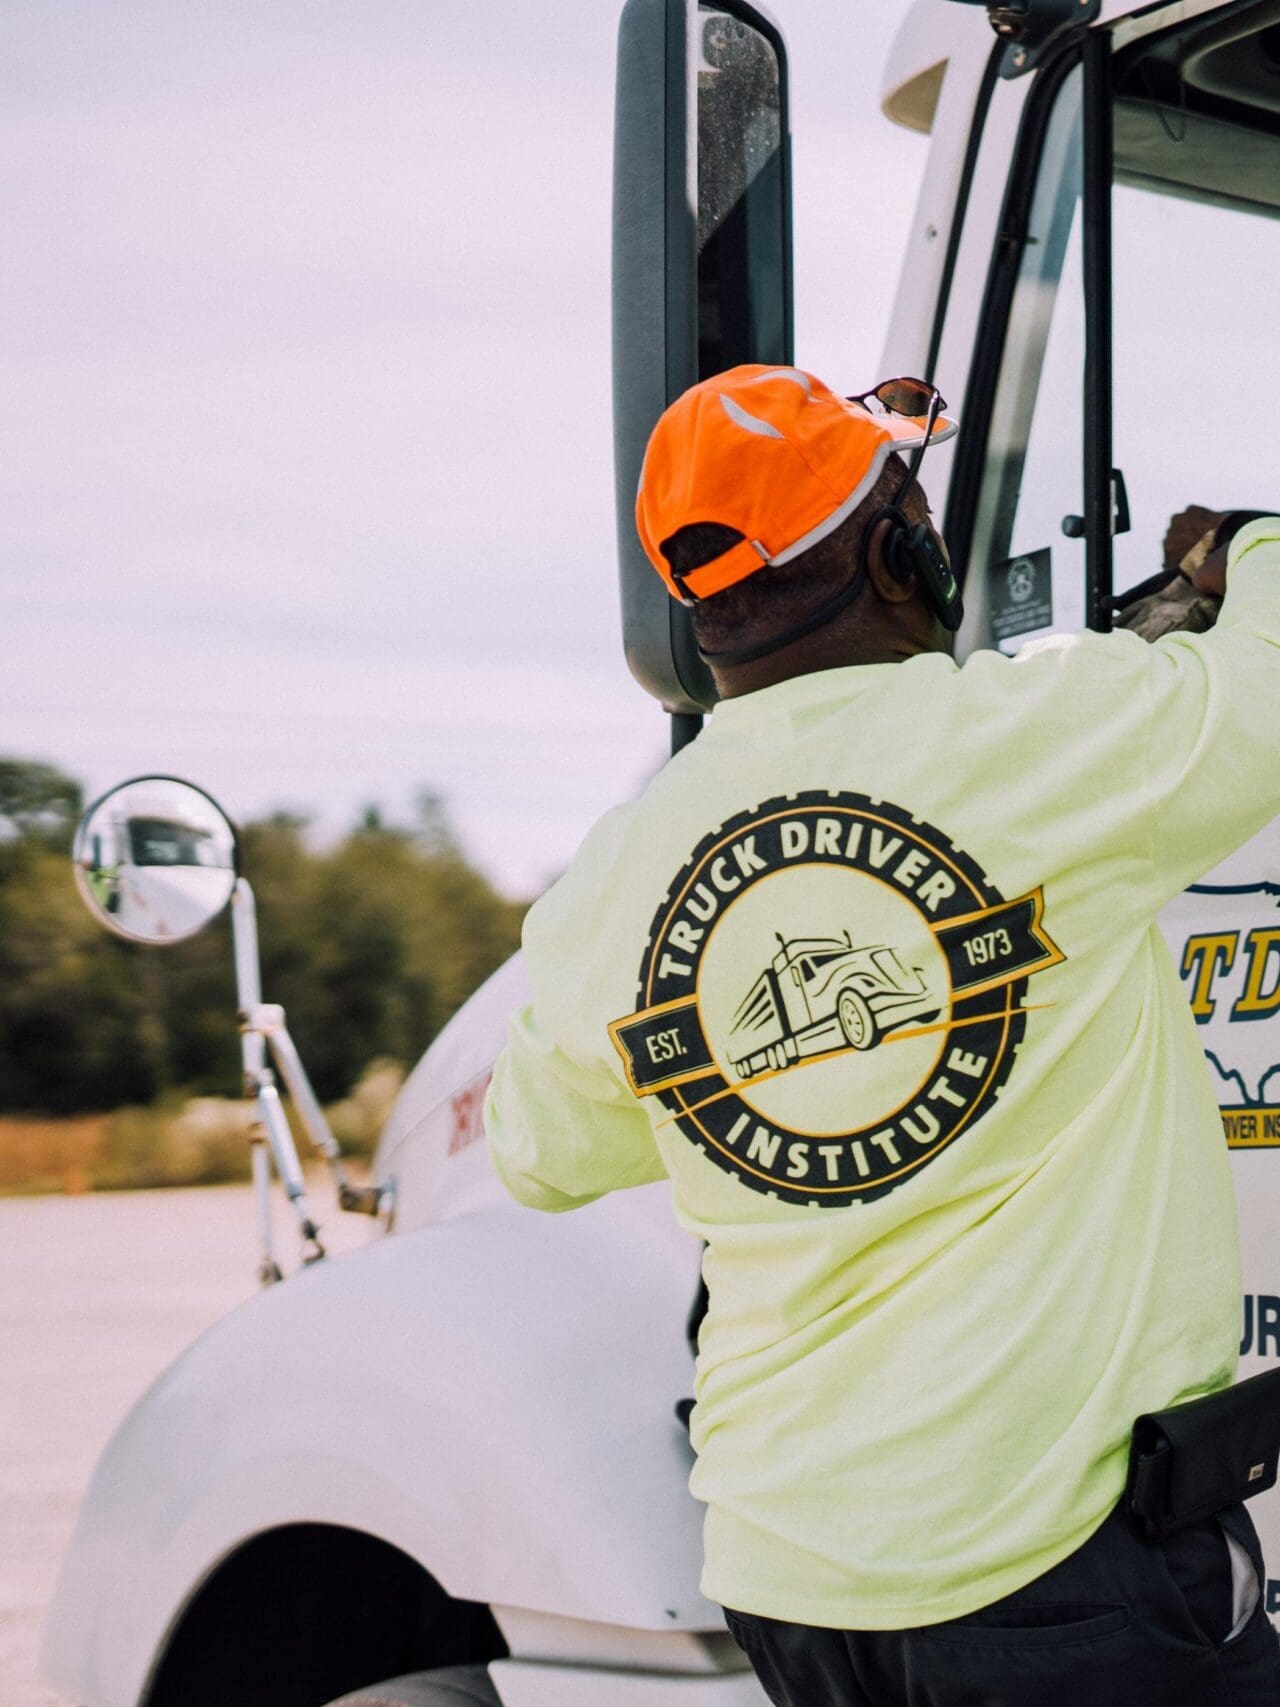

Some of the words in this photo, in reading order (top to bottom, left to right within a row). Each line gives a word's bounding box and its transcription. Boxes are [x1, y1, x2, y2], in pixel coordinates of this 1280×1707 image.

[659, 835, 767, 980] TRUCK
[780, 818, 957, 912] DRIVER
[962, 929, 1012, 966] 1973
[646, 1028, 688, 1063] EST.
[725, 1045, 987, 1180] INSTITUTE
